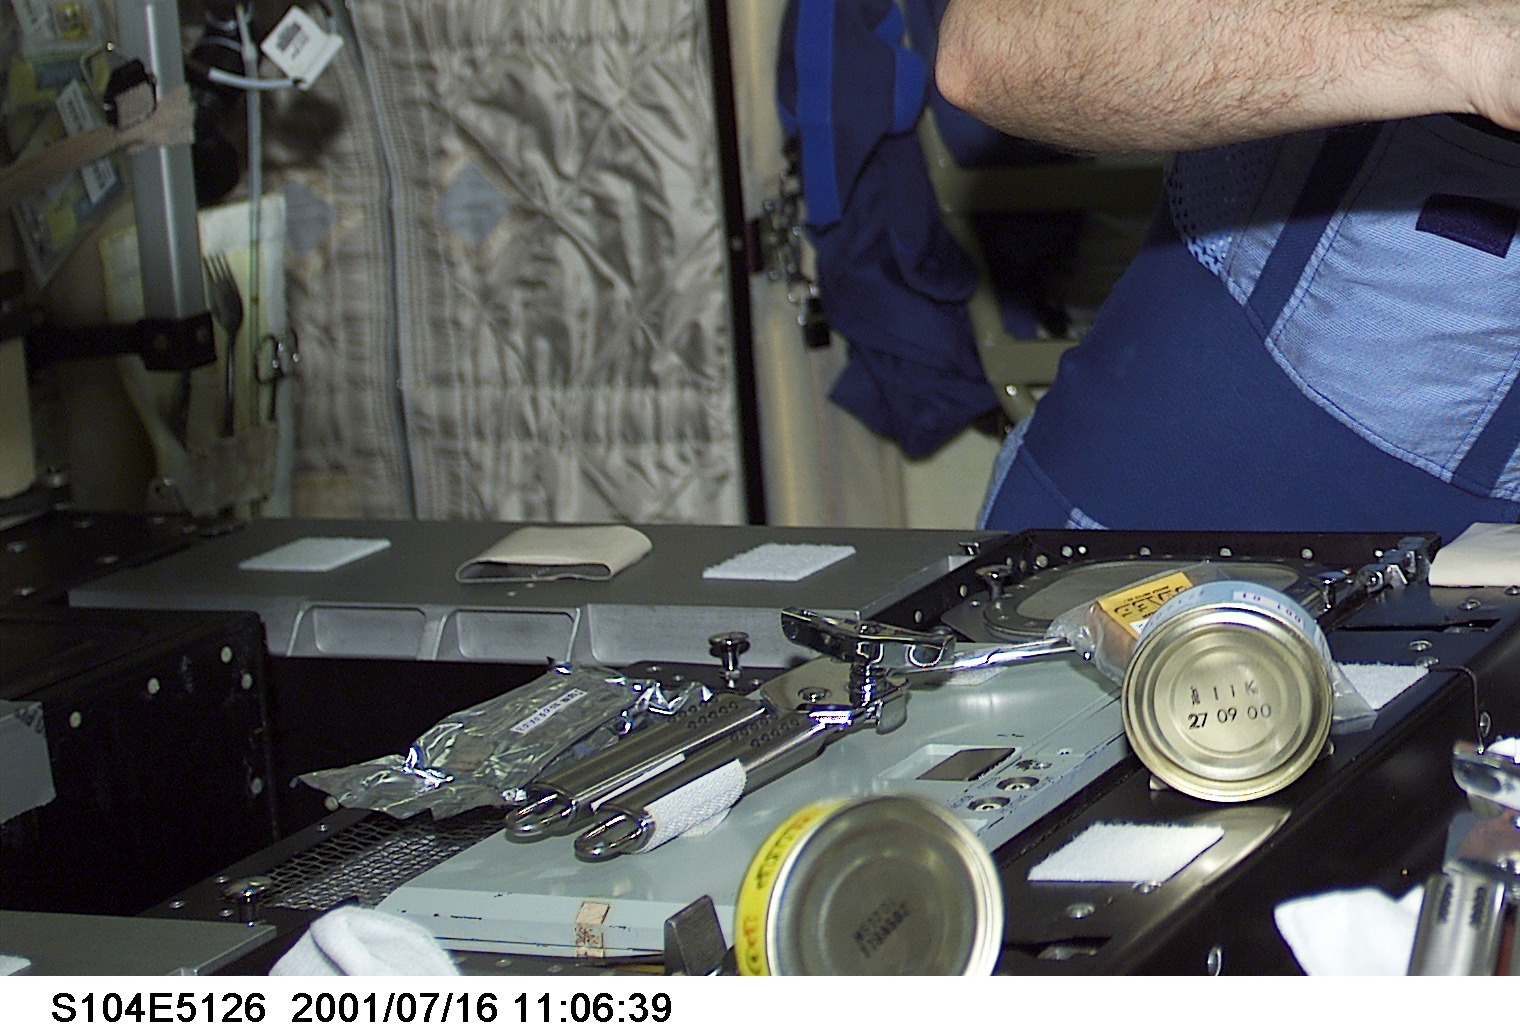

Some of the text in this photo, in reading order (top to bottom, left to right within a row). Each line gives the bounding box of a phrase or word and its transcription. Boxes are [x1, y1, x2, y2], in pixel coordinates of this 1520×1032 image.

[1187, 703, 1272, 730] 27 09 00
